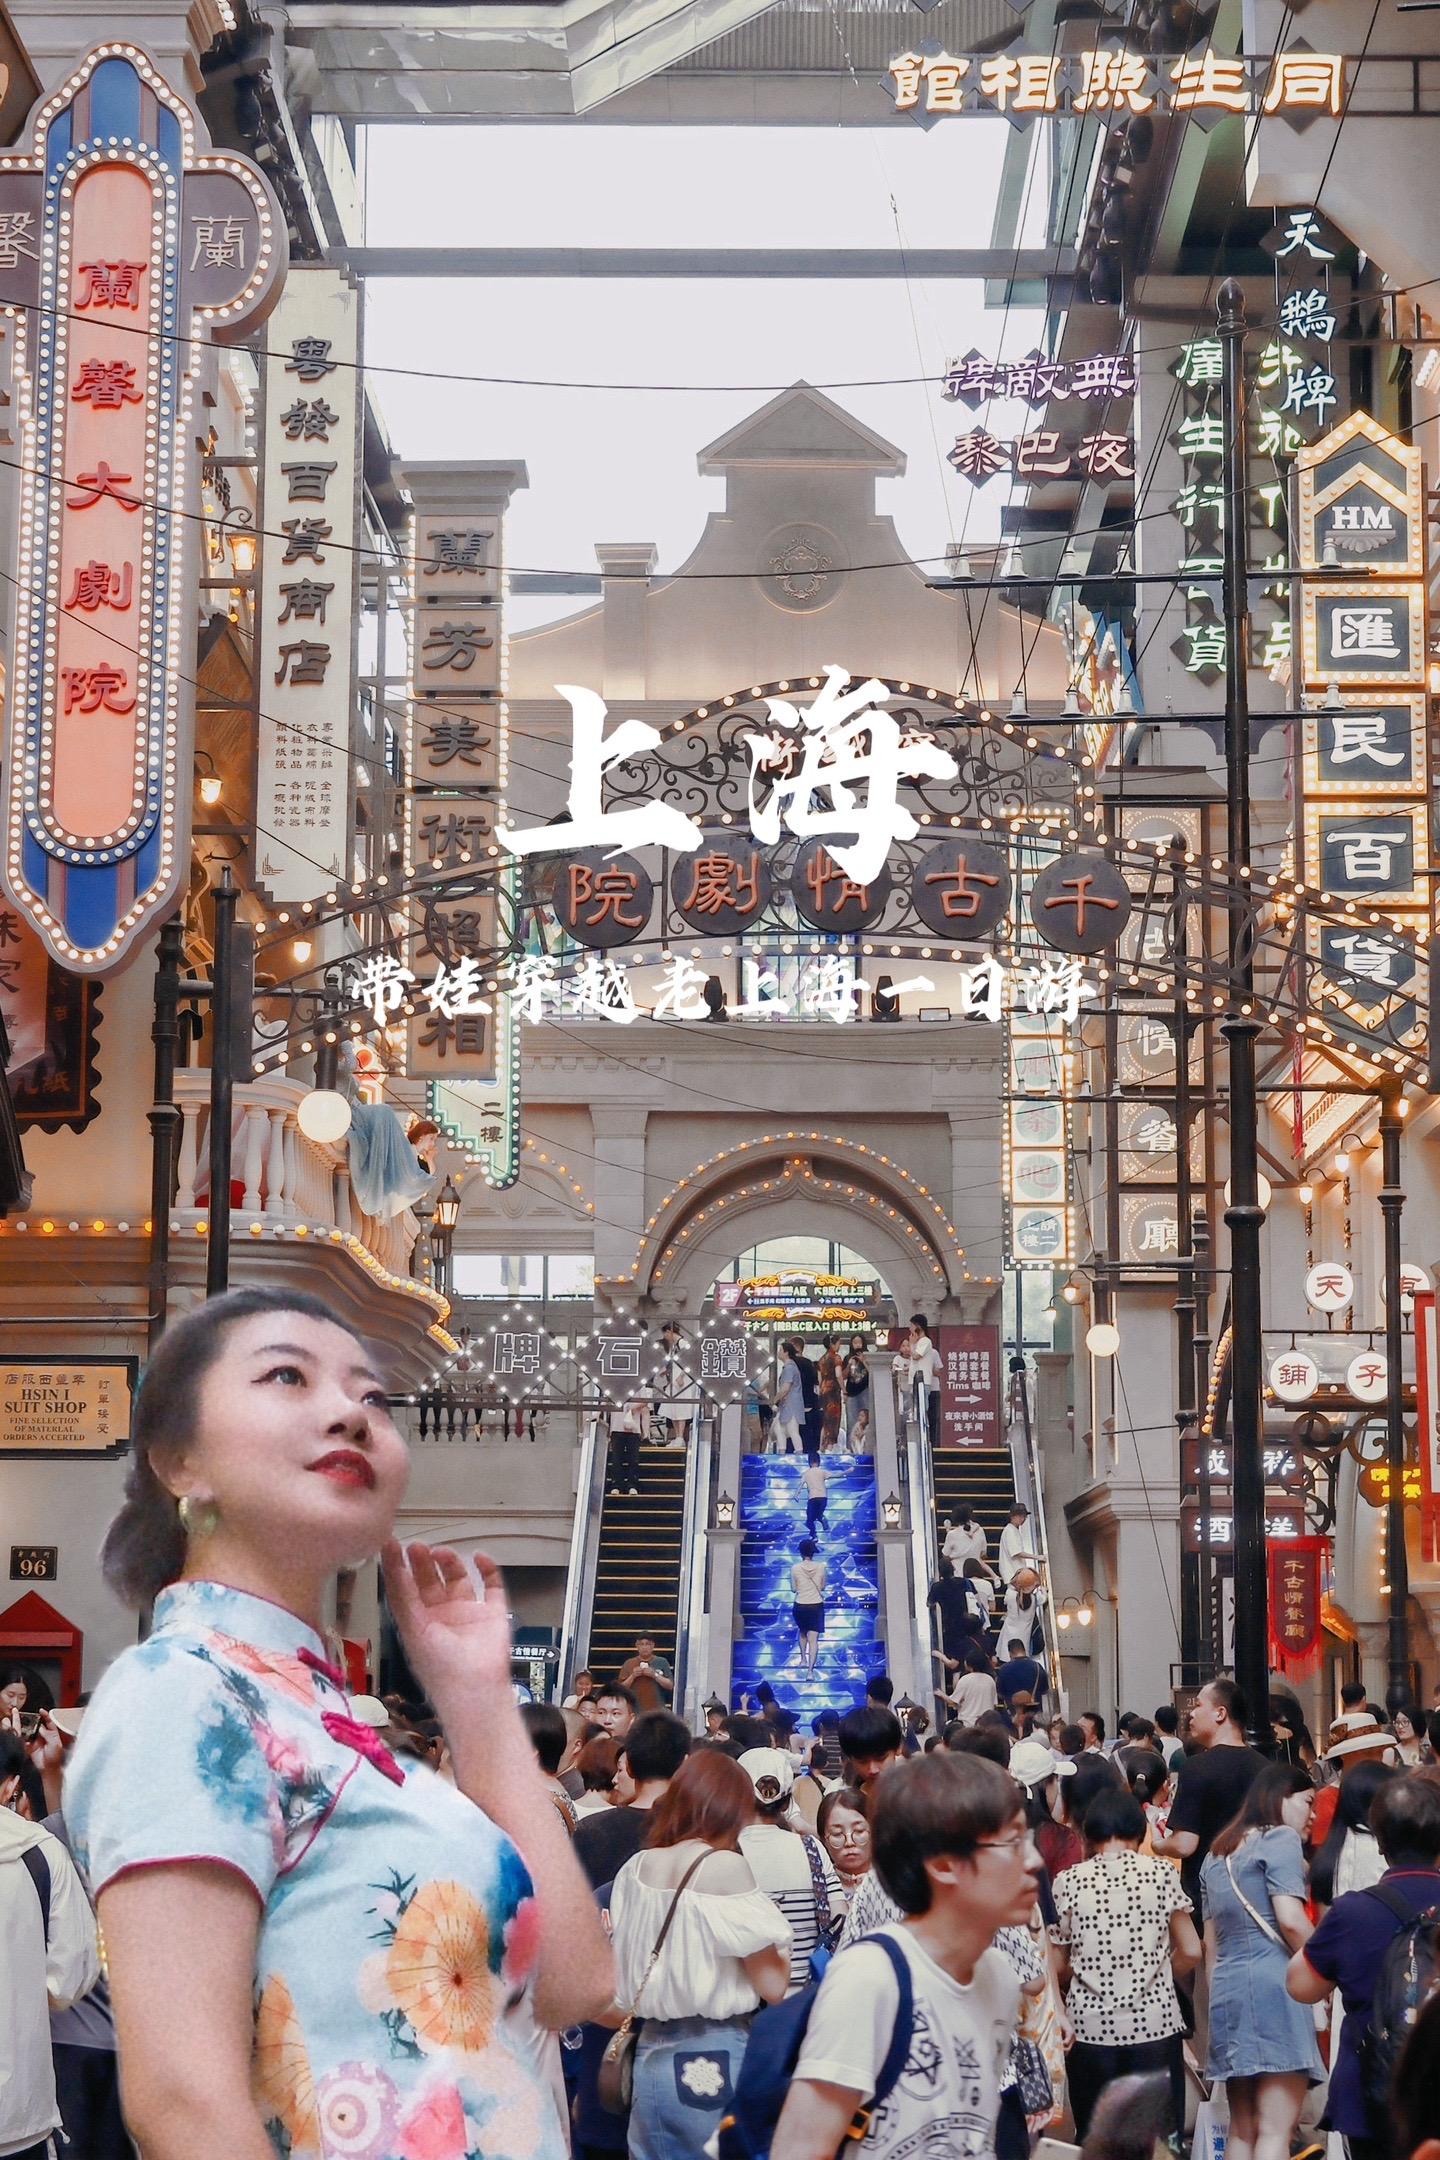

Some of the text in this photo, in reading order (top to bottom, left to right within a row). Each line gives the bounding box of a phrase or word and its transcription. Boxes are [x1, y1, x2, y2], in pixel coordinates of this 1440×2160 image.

[1275, 211, 1337, 426] 天鵝牌
[61, 258, 148, 717] 蘭馨大劇院
[274, 335, 340, 686] 粵發百貨商店
[1332, 505, 1393, 531] HM
[1326, 606, 1407, 987] 匯民百貨
[721, 1288, 739, 1303] 2F
[21, 1388, 71, 1401] HSIN I
[947, 1381, 970, 1390] Tims
[4, 1401, 87, 1414] SUIT SHOP
[953, 1422, 984, 1432] 洗手间
[20, 1559, 47, 1577] 96
